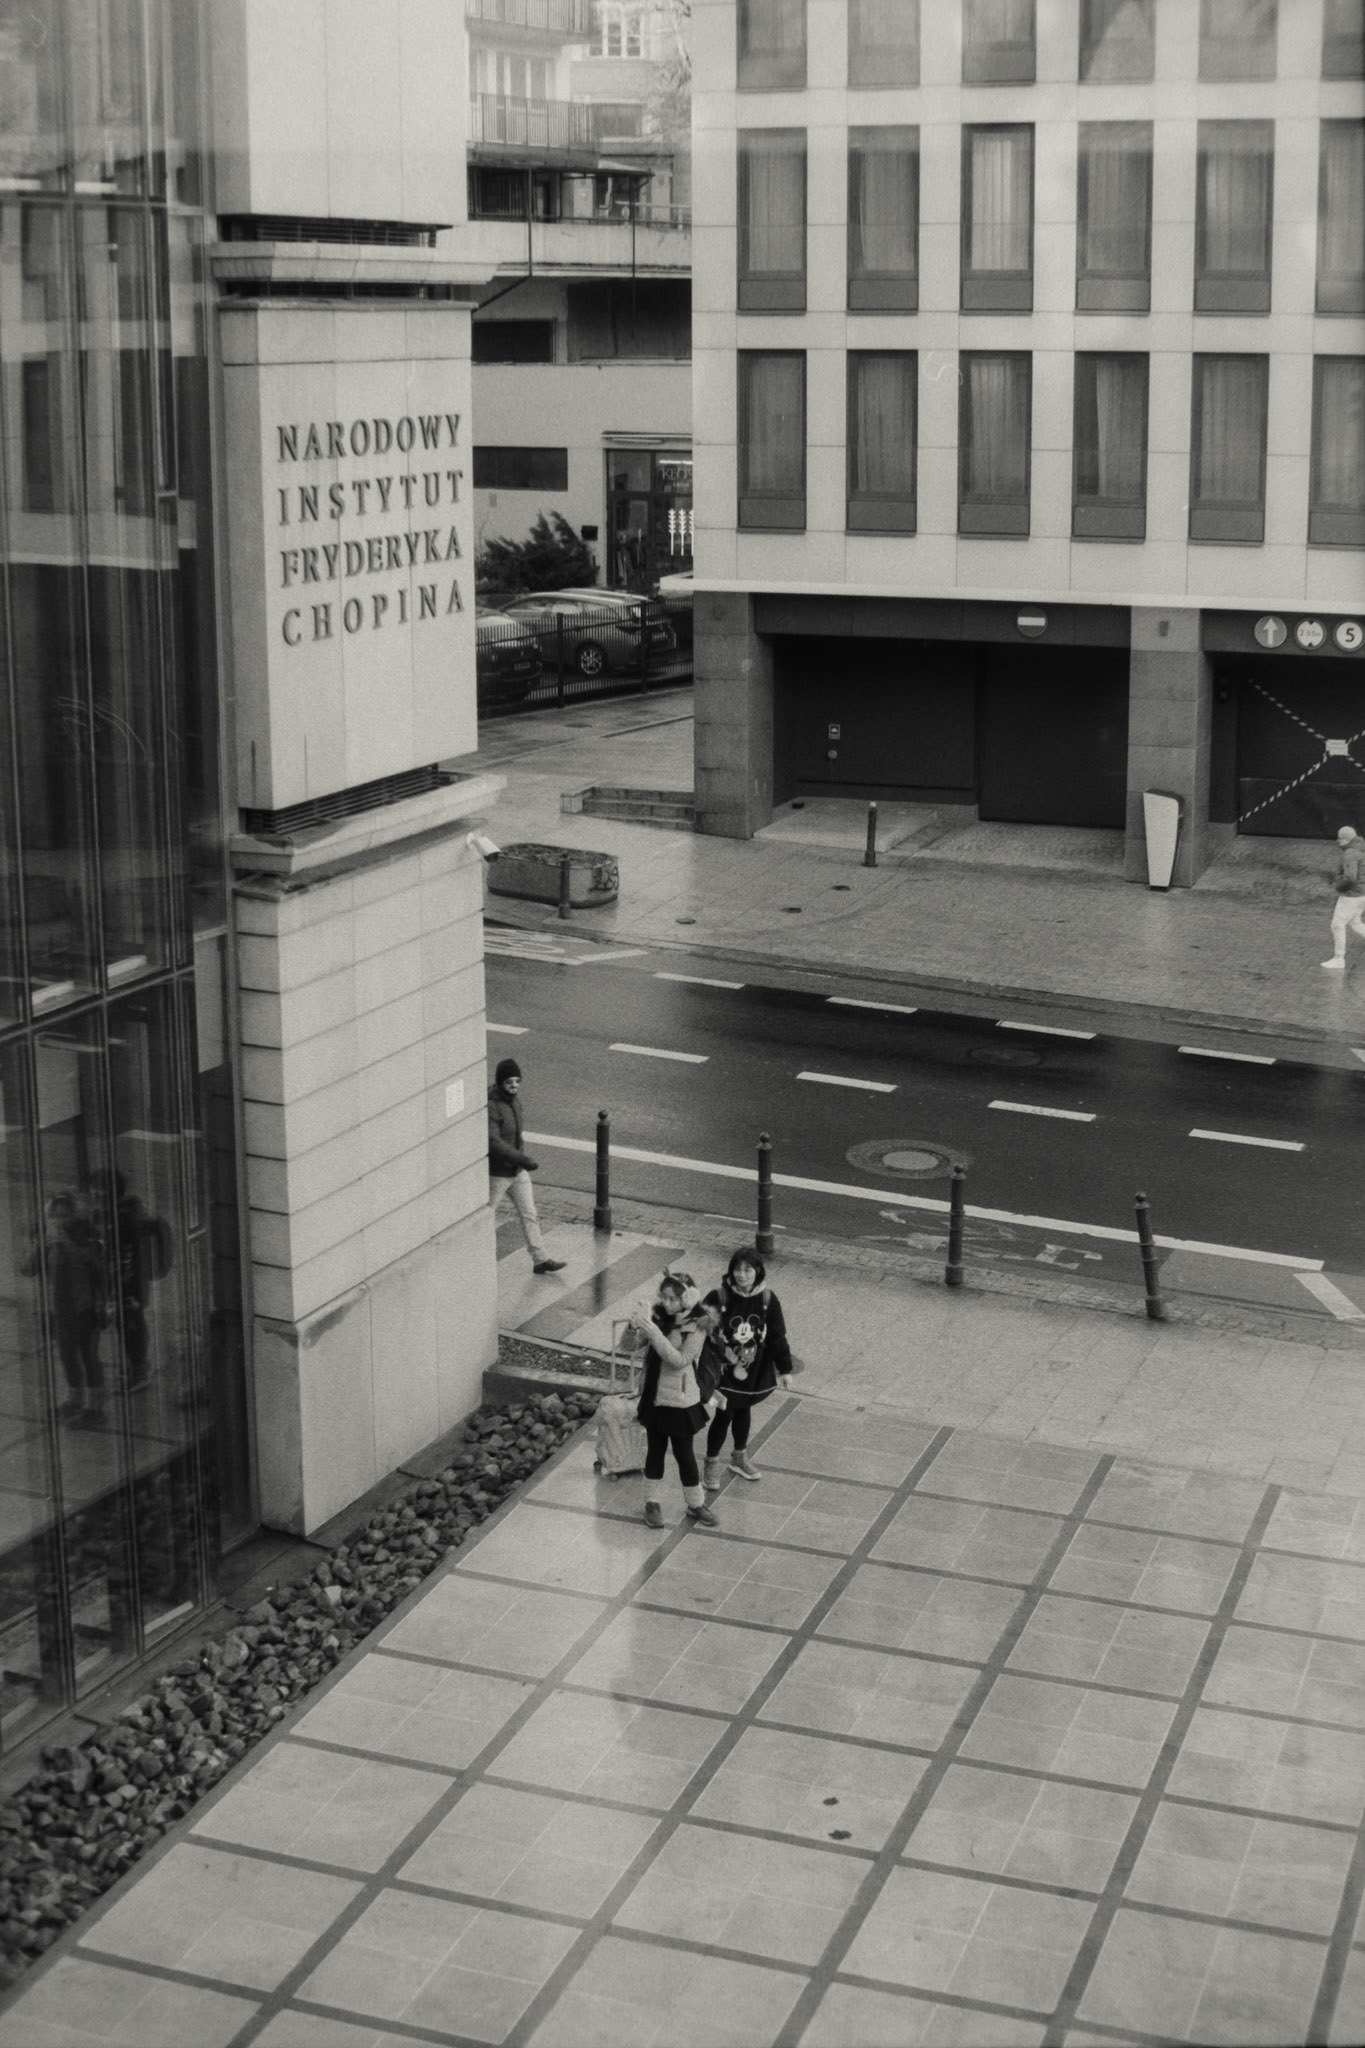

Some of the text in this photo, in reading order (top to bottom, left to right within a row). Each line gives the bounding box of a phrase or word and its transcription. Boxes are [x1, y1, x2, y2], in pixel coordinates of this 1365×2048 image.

[276, 413, 462, 463] NARODOWY
[278, 469, 463, 526] INSTYTUT
[279, 525, 463, 589] FRYDERYKA
[281, 578, 464, 647] CHOPINA
[1345, 627, 1355, 643] 5
